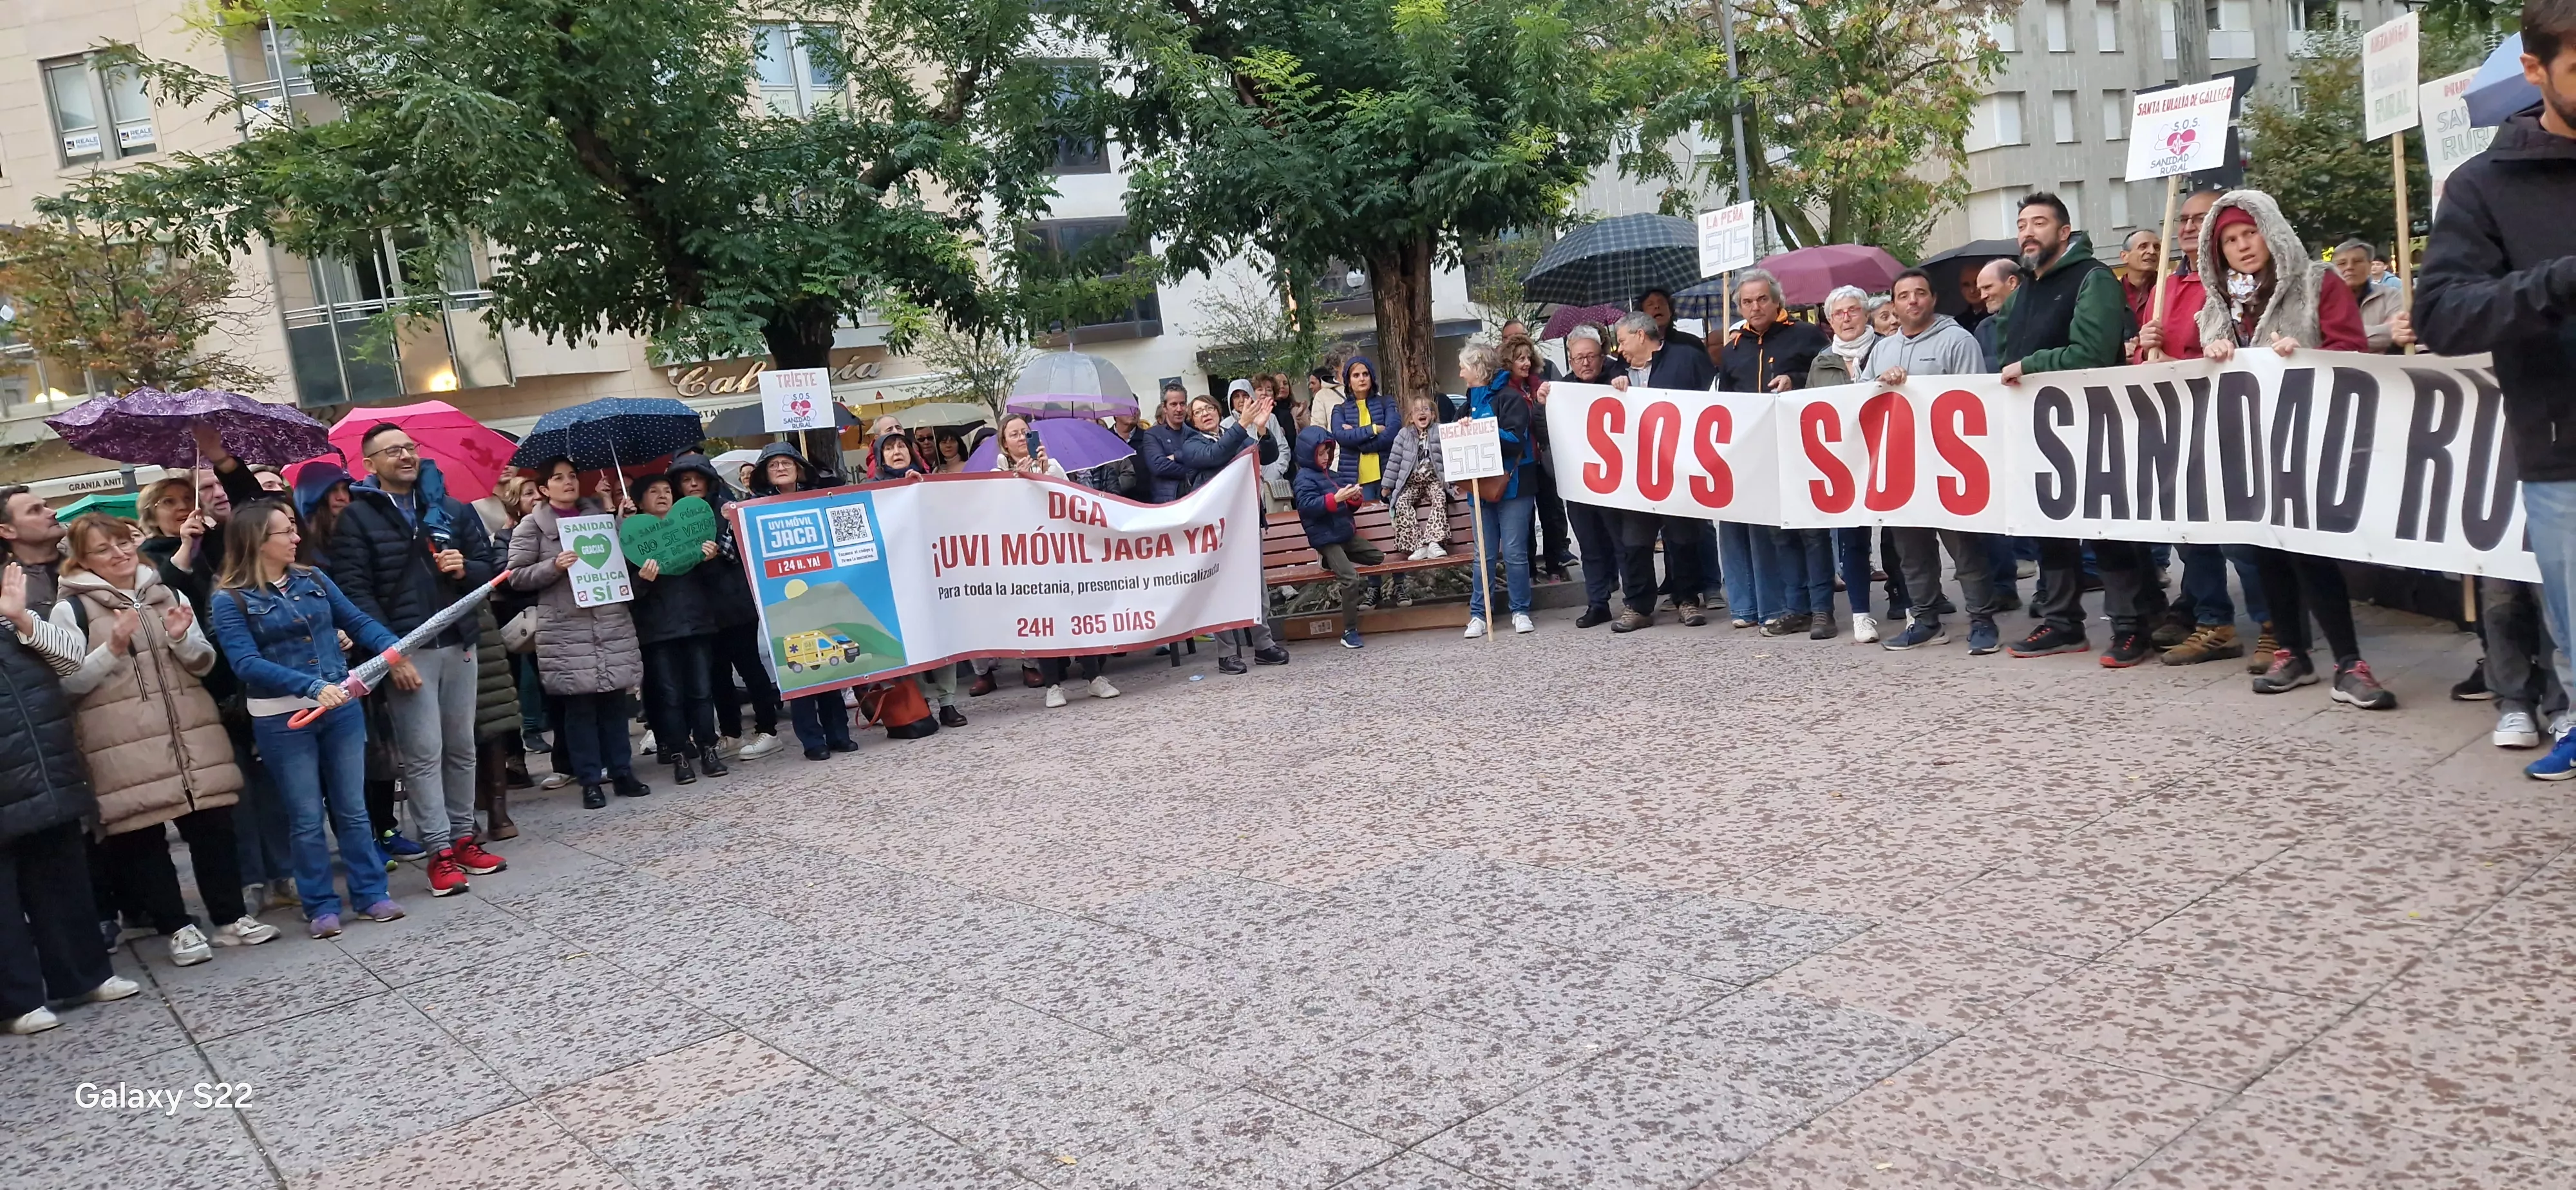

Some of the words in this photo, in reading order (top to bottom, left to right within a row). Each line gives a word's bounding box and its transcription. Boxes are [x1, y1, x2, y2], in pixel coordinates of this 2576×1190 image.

[2444, 79, 2471, 97] MUR
[2137, 100, 2160, 117] SANTA
[2190, 93, 2197, 107] DE
[2174, 118, 2201, 132] S.O.S.
[2442, 126, 2499, 160] RUR
[2150, 153, 2190, 169] SANIDAD
[2159, 165, 2188, 175] RURAL
[1707, 215, 1718, 229] LA
[1721, 207, 1744, 225] PEÑA
[1706, 223, 1750, 268] SOS
[776, 372, 817, 388] TRISTE
[783, 415, 811, 424] SANIDAD
[1448, 442, 1498, 476] SOS
[1583, 396, 1734, 509] SOS
[1799, 389, 1991, 517] SOS
[2032, 366, 2381, 534] SANIDAD
[2395, 367, 2535, 552] RU
[68, 480, 101, 491] GRANJA
[104, 477, 123, 487] ANIT
[1048, 490, 1108, 529] DGA
[564, 521, 614, 533] SANIDAD
[768, 521, 785, 531] UVI
[786, 516, 813, 528] MÓVIL
[638, 538, 658, 556] NO
[662, 529, 681, 547] SE
[770, 525, 818, 548] JACA
[931, 534, 990, 578] ¡UVI
[1001, 525, 1094, 566] MÓVIL
[1101, 533, 1175, 563] JACA
[1182, 517, 1227, 554] YA!
[784, 561, 795, 572] 24
[798, 559, 806, 569] H.
[806, 556, 821, 568] YA!
[575, 571, 626, 585] PÚBLICA
[938, 585, 961, 600] Para
[964, 582, 992, 596] toda
[996, 582, 1007, 596] la
[1010, 580, 1074, 596] Jacetania,
[1077, 579, 1140, 595] presencial
[1143, 577, 1150, 590] y
[1153, 562, 1220, 587] medicalizada
[592, 581, 613, 602] SÍ
[1016, 616, 1055, 638] 24H
[1070, 614, 1108, 636] 365
[1112, 607, 1157, 632] DÍAS
